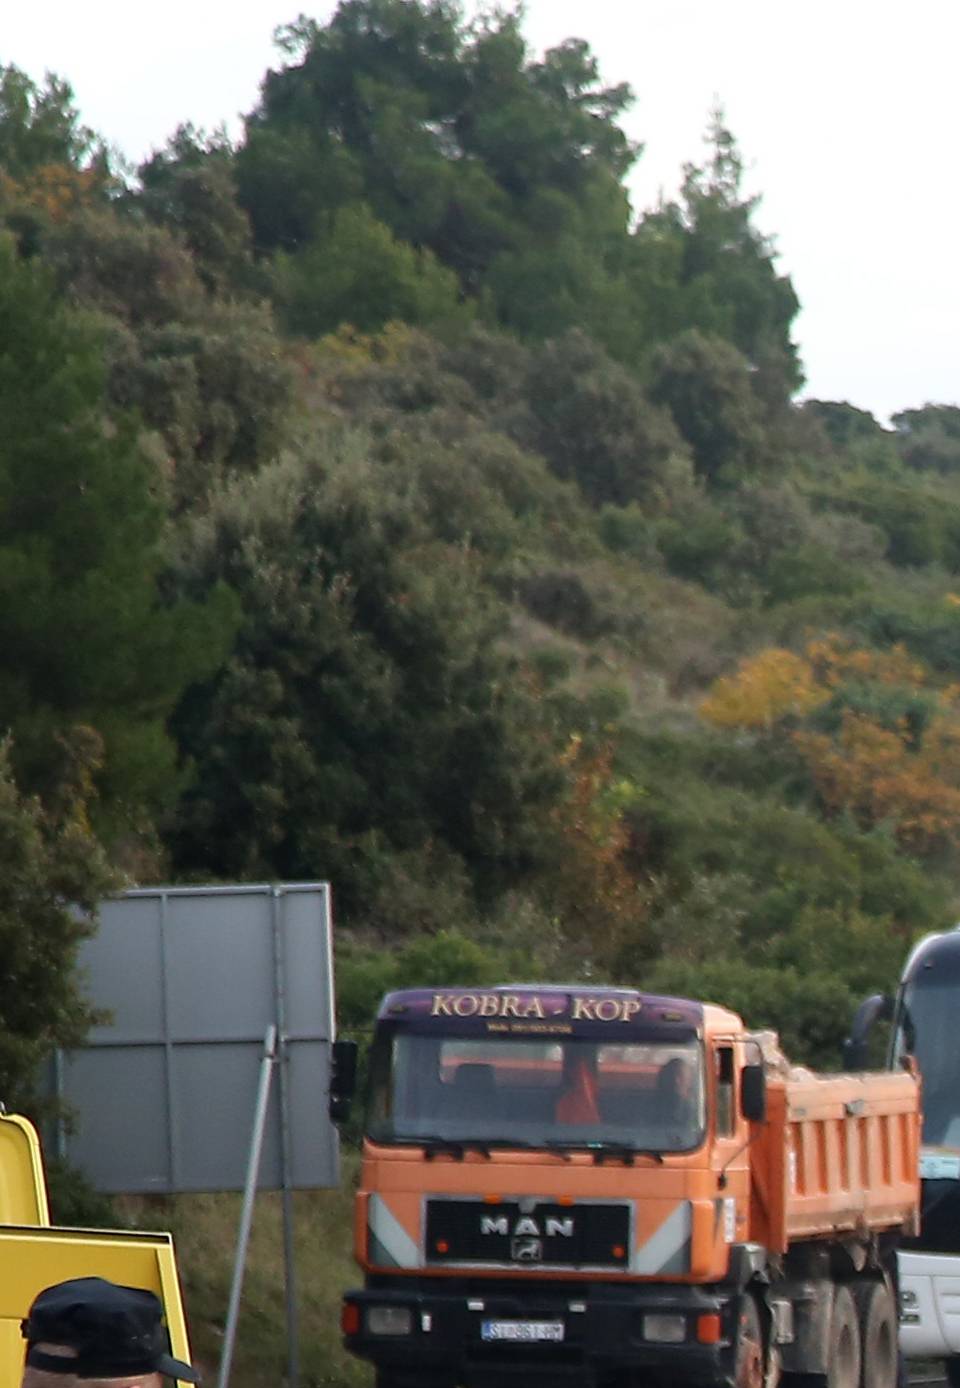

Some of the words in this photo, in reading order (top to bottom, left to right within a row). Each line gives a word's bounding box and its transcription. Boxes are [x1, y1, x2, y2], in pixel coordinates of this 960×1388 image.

[430, 994, 546, 1019] KOBRA
[570, 997, 642, 1022] KOP
[480, 1216, 574, 1237] MAN
